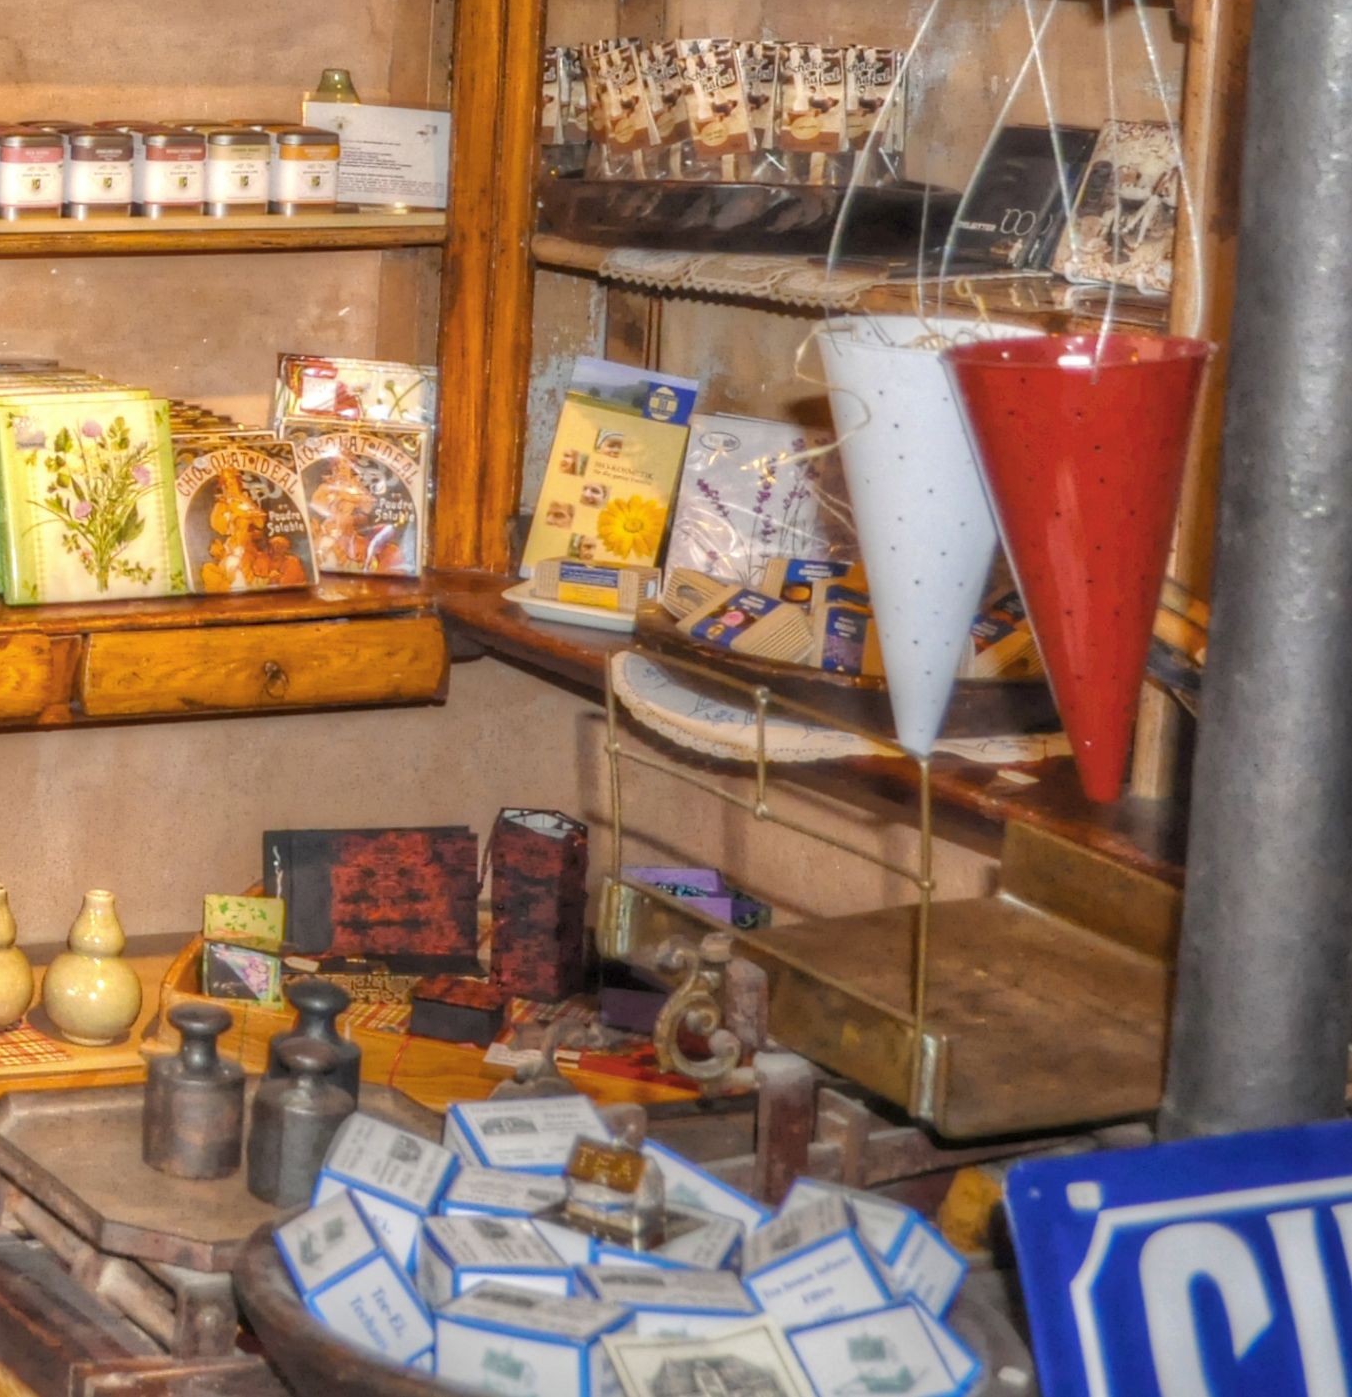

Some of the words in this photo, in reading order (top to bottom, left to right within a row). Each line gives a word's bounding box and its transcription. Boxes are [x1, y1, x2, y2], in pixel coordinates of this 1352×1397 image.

[176, 450, 250, 498] CHOCOLAT
[254, 452, 299, 496] IDEAL
[376, 440, 420, 486] IDEAL
[269, 510, 301, 522] Poudre
